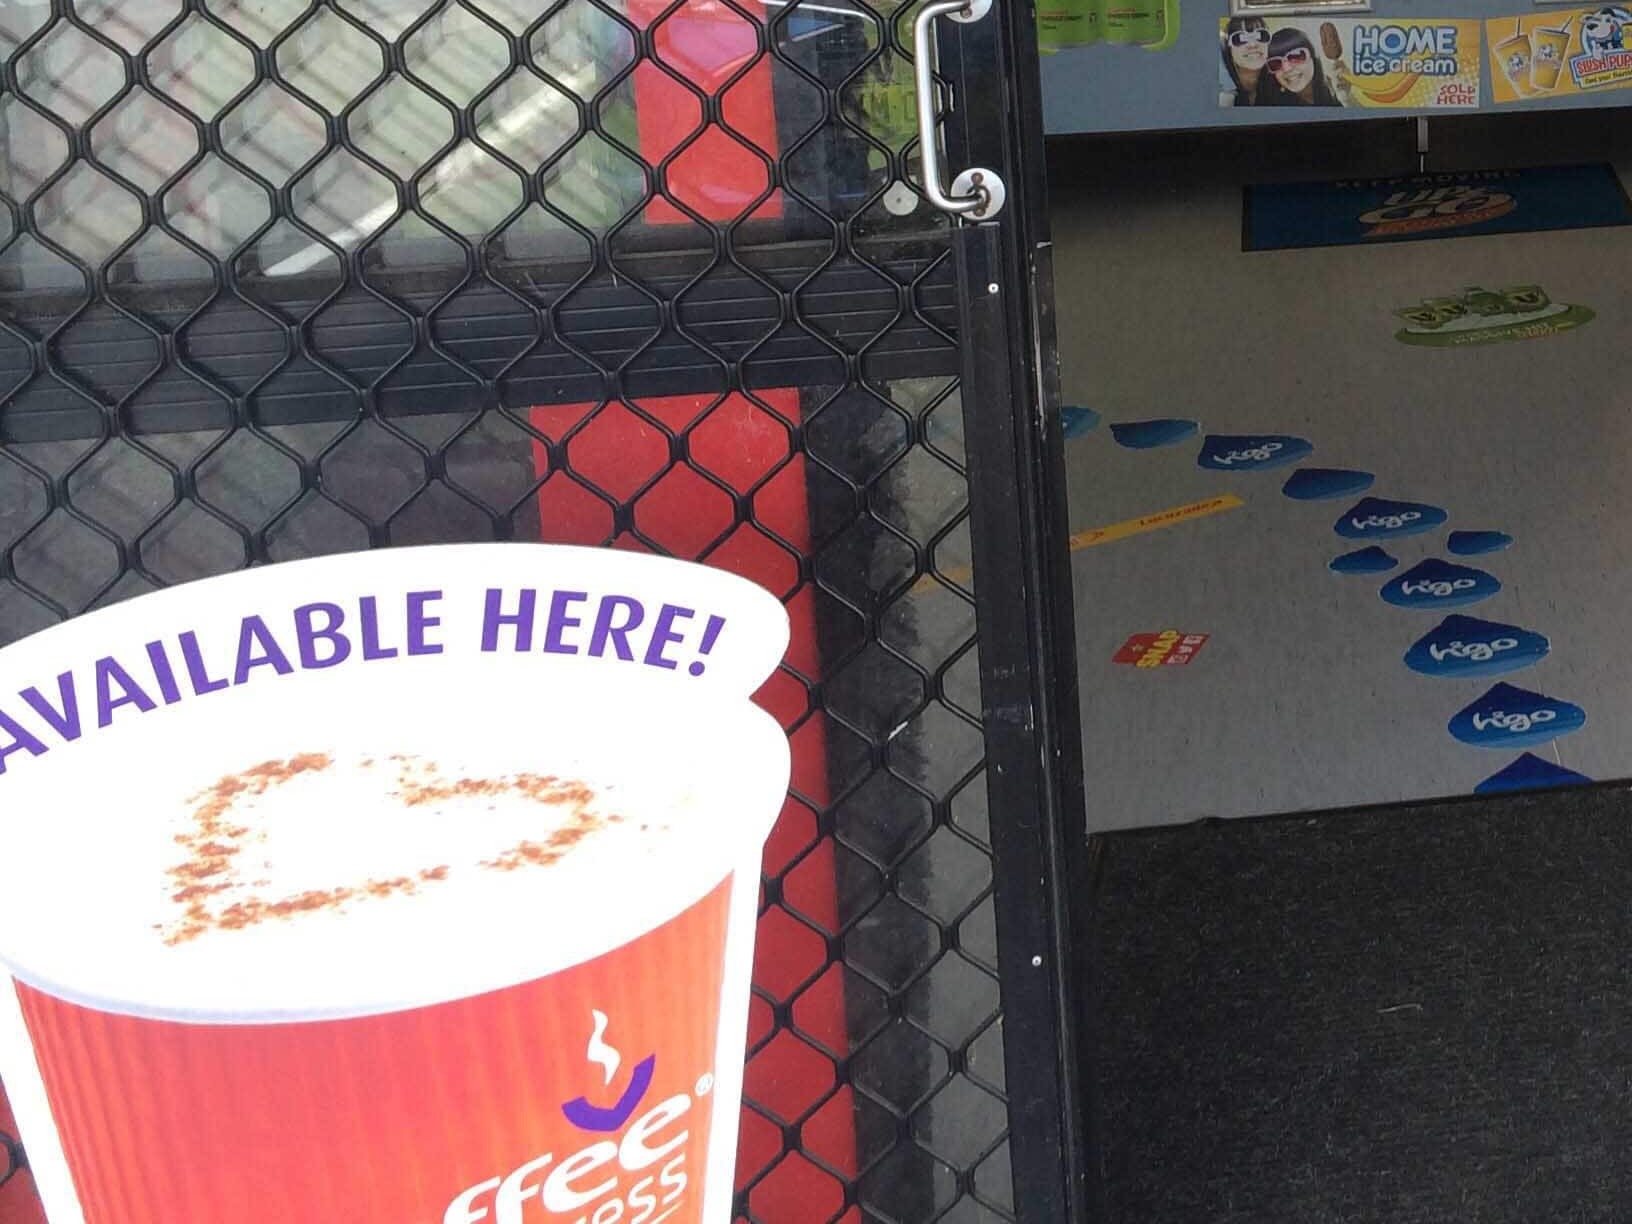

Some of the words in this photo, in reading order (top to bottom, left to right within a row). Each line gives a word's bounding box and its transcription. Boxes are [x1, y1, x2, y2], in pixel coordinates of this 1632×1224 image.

[1354, 26, 1457, 55] HOME
[1354, 55, 1386, 73] ice
[1389, 58, 1455, 73] cream
[1440, 83, 1476, 96] SOLD
[1436, 95, 1475, 105] HERE
[0, 589, 445, 774] AVAILABLE
[480, 588, 727, 677] HERE!
